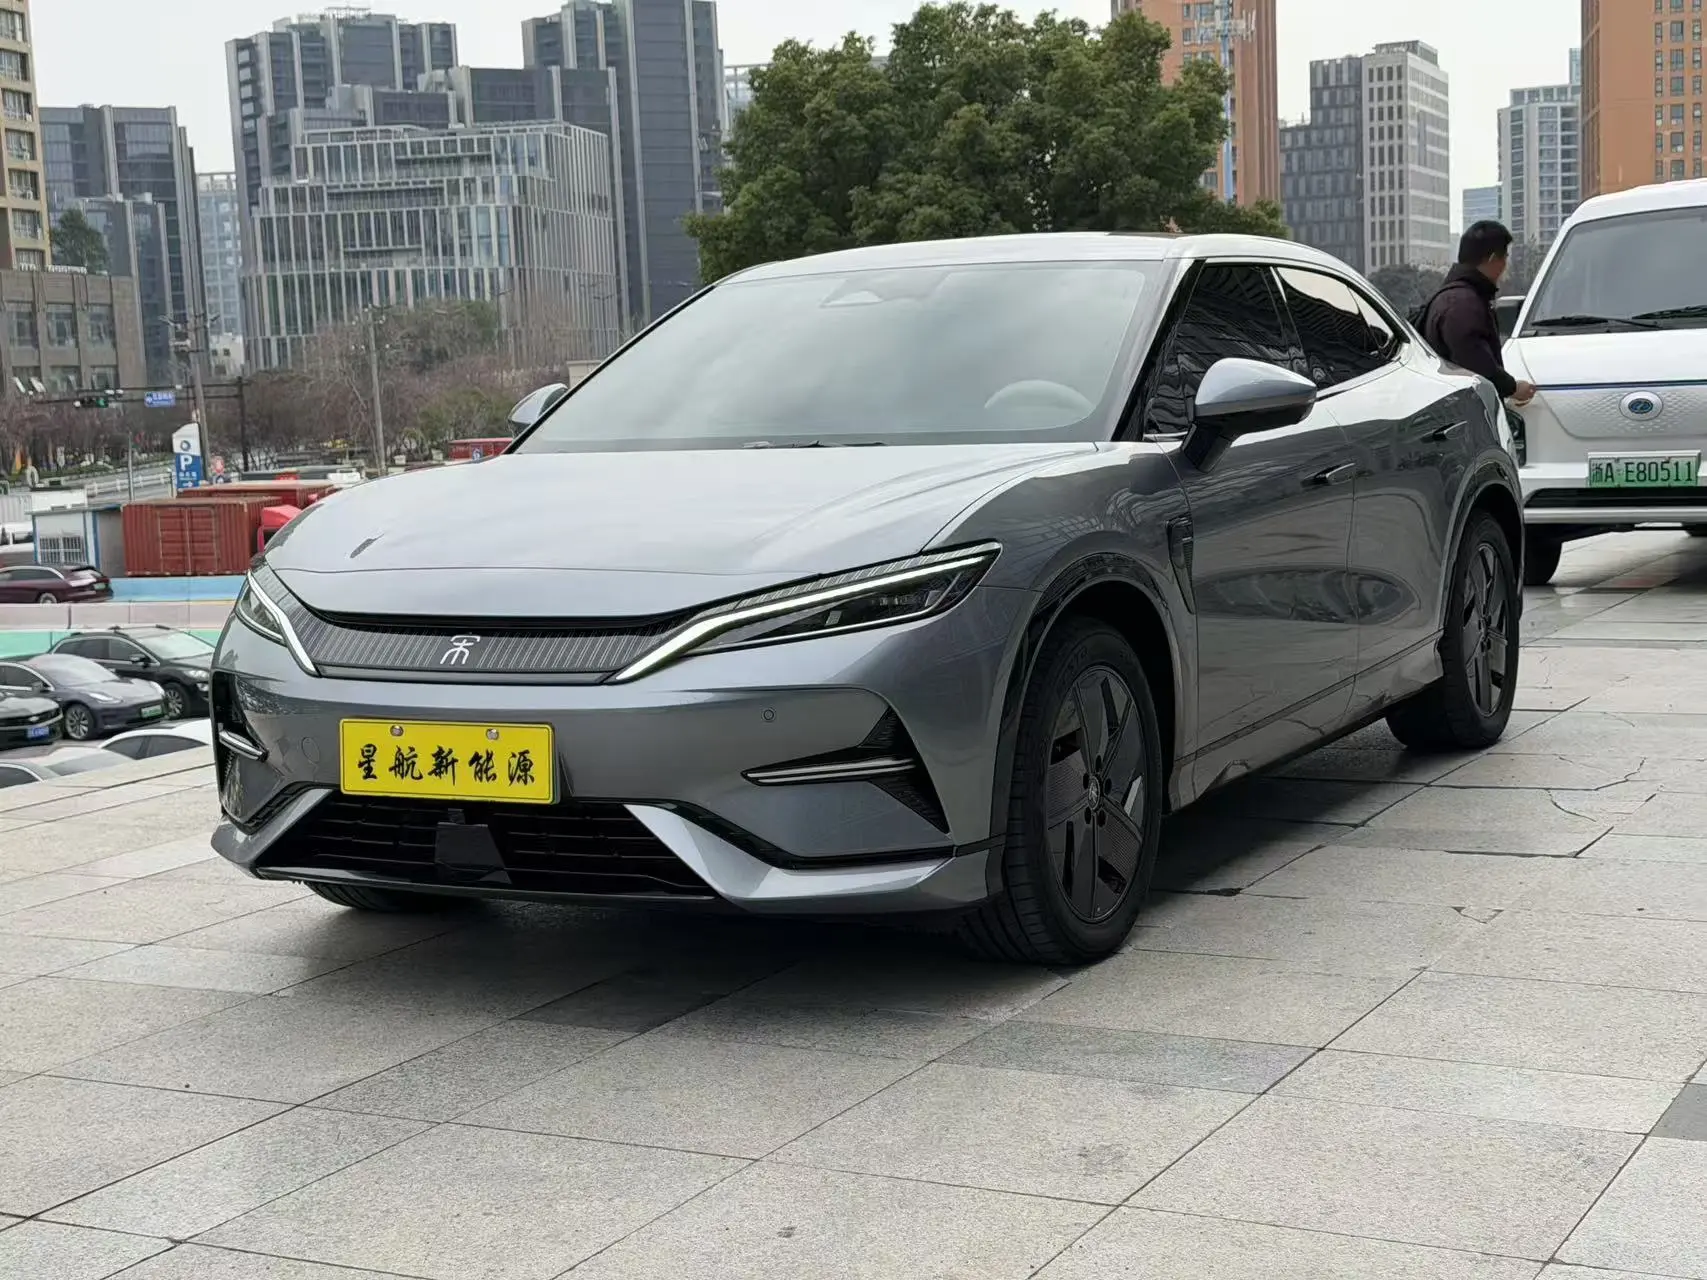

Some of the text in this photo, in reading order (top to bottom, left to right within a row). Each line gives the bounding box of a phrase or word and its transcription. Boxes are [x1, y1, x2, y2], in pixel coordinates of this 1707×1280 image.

[180, 455, 193, 471] P
[1624, 460, 1693, 483] E80511
[357, 743, 535, 786] 星航新能源
